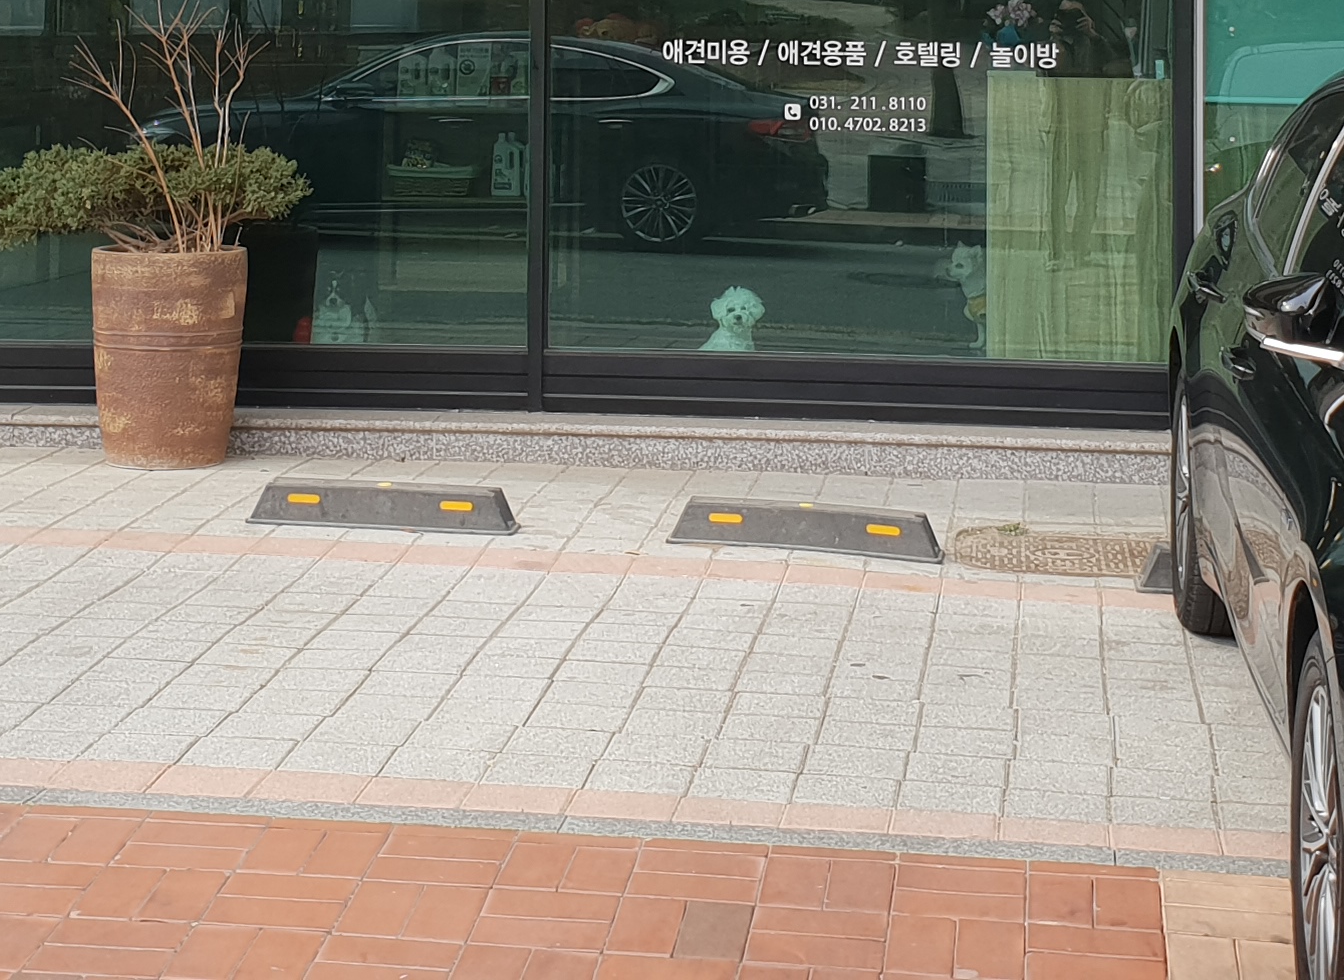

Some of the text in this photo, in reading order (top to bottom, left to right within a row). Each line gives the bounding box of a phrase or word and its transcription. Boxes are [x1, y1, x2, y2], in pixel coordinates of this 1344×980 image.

[662, 39, 751, 65] 애견미용
[777, 40, 867, 67] 애견용품
[893, 41, 961, 68] 호텔링
[989, 42, 1060, 69] 놀이방
